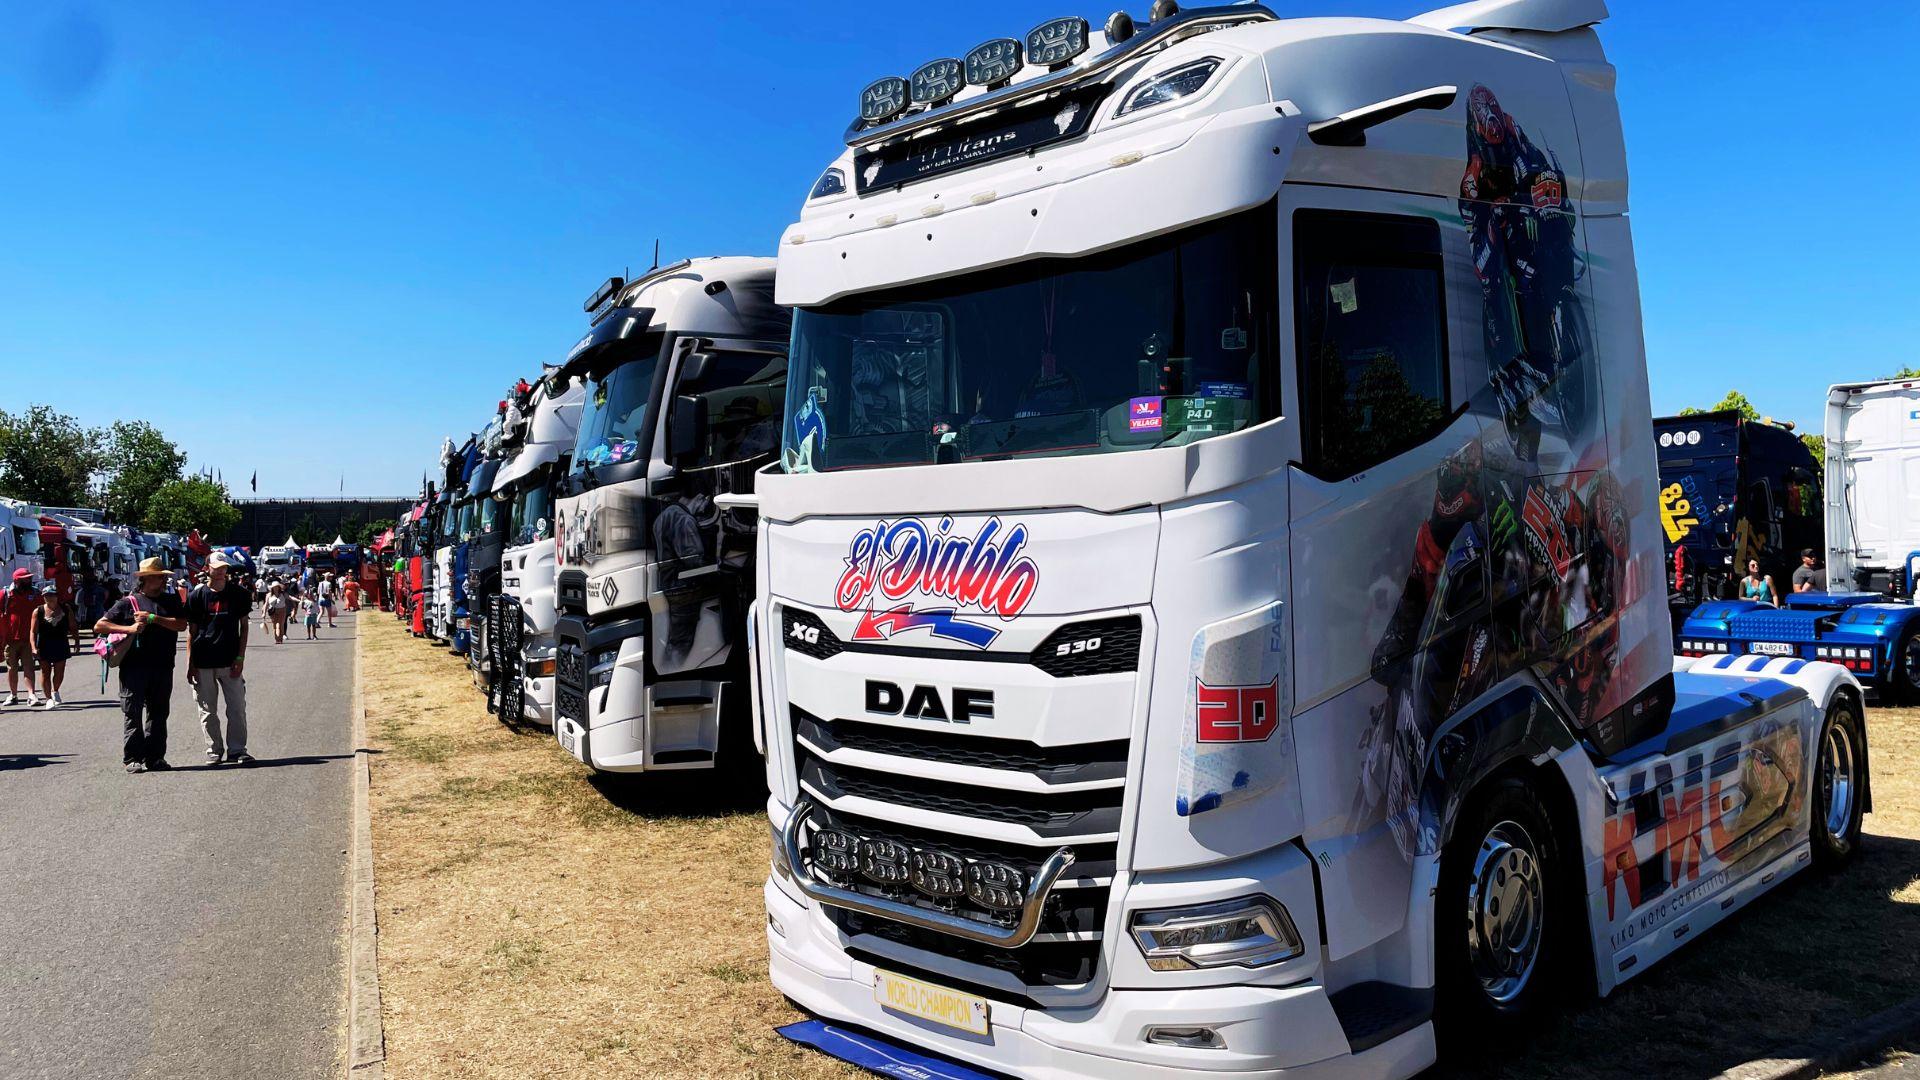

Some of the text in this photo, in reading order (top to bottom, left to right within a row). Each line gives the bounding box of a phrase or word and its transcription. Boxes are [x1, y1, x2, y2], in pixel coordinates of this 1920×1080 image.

[1531, 179, 1562, 212] 20
[1132, 418, 1160, 428] VILLAGE
[1187, 409, 1213, 419] P4 D
[1522, 484, 1571, 583] 20
[835, 514, 1039, 621] El Diablo
[789, 622, 820, 645] XG
[1056, 638, 1101, 656] 530
[865, 679, 995, 724] DAF
[1196, 673, 1279, 743] 20
[1640, 906, 1667, 931] MOTO
[886, 978, 972, 1025] WORLD CHAMPION
